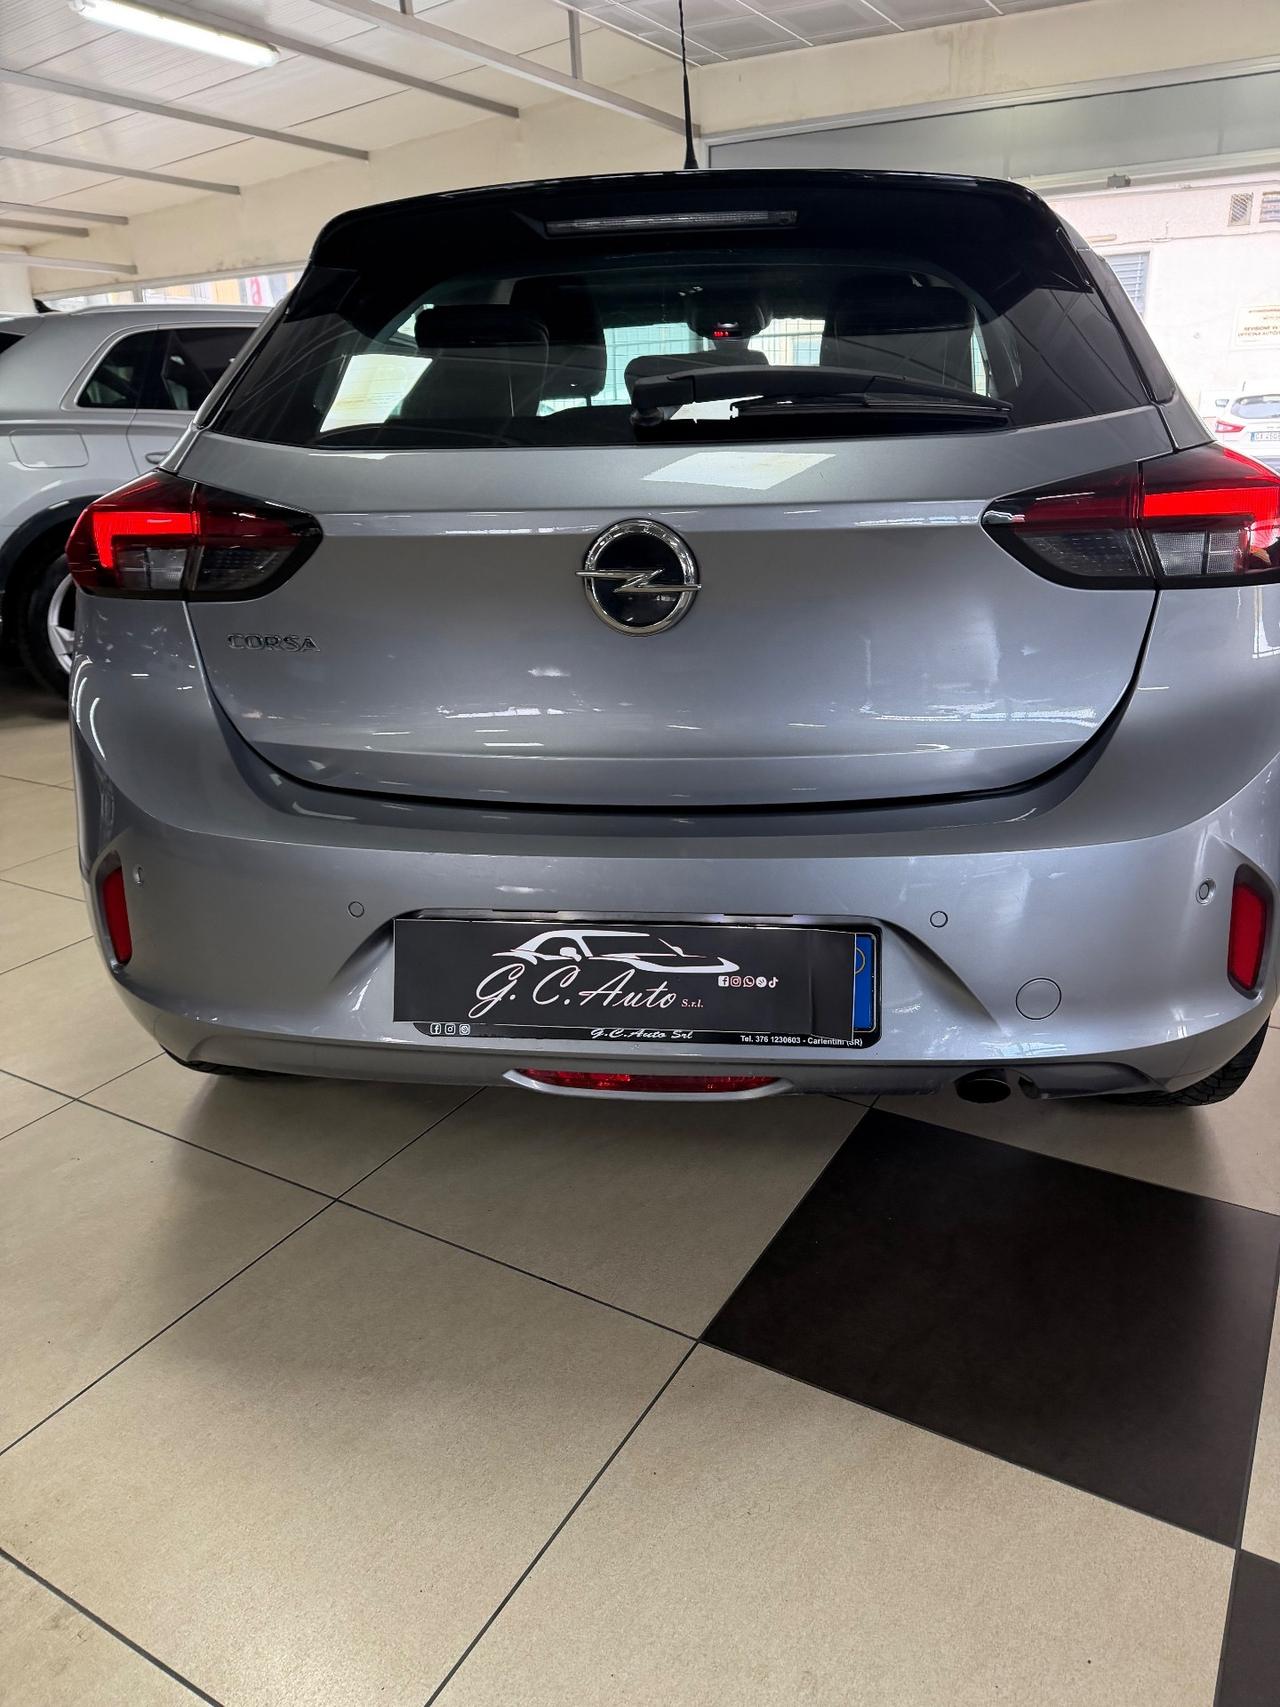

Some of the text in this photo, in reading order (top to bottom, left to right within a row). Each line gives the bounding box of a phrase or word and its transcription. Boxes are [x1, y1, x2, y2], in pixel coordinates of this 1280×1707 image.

[227, 632, 321, 652] CORSA
[578, 968, 678, 1009] Auto
[681, 999, 704, 1008] S.r.l.
[670, 1029, 694, 1039] Srl
[740, 1035, 754, 1043] Tel.
[755, 1035, 769, 1043] 376
[770, 1036, 801, 1044] 1230603
